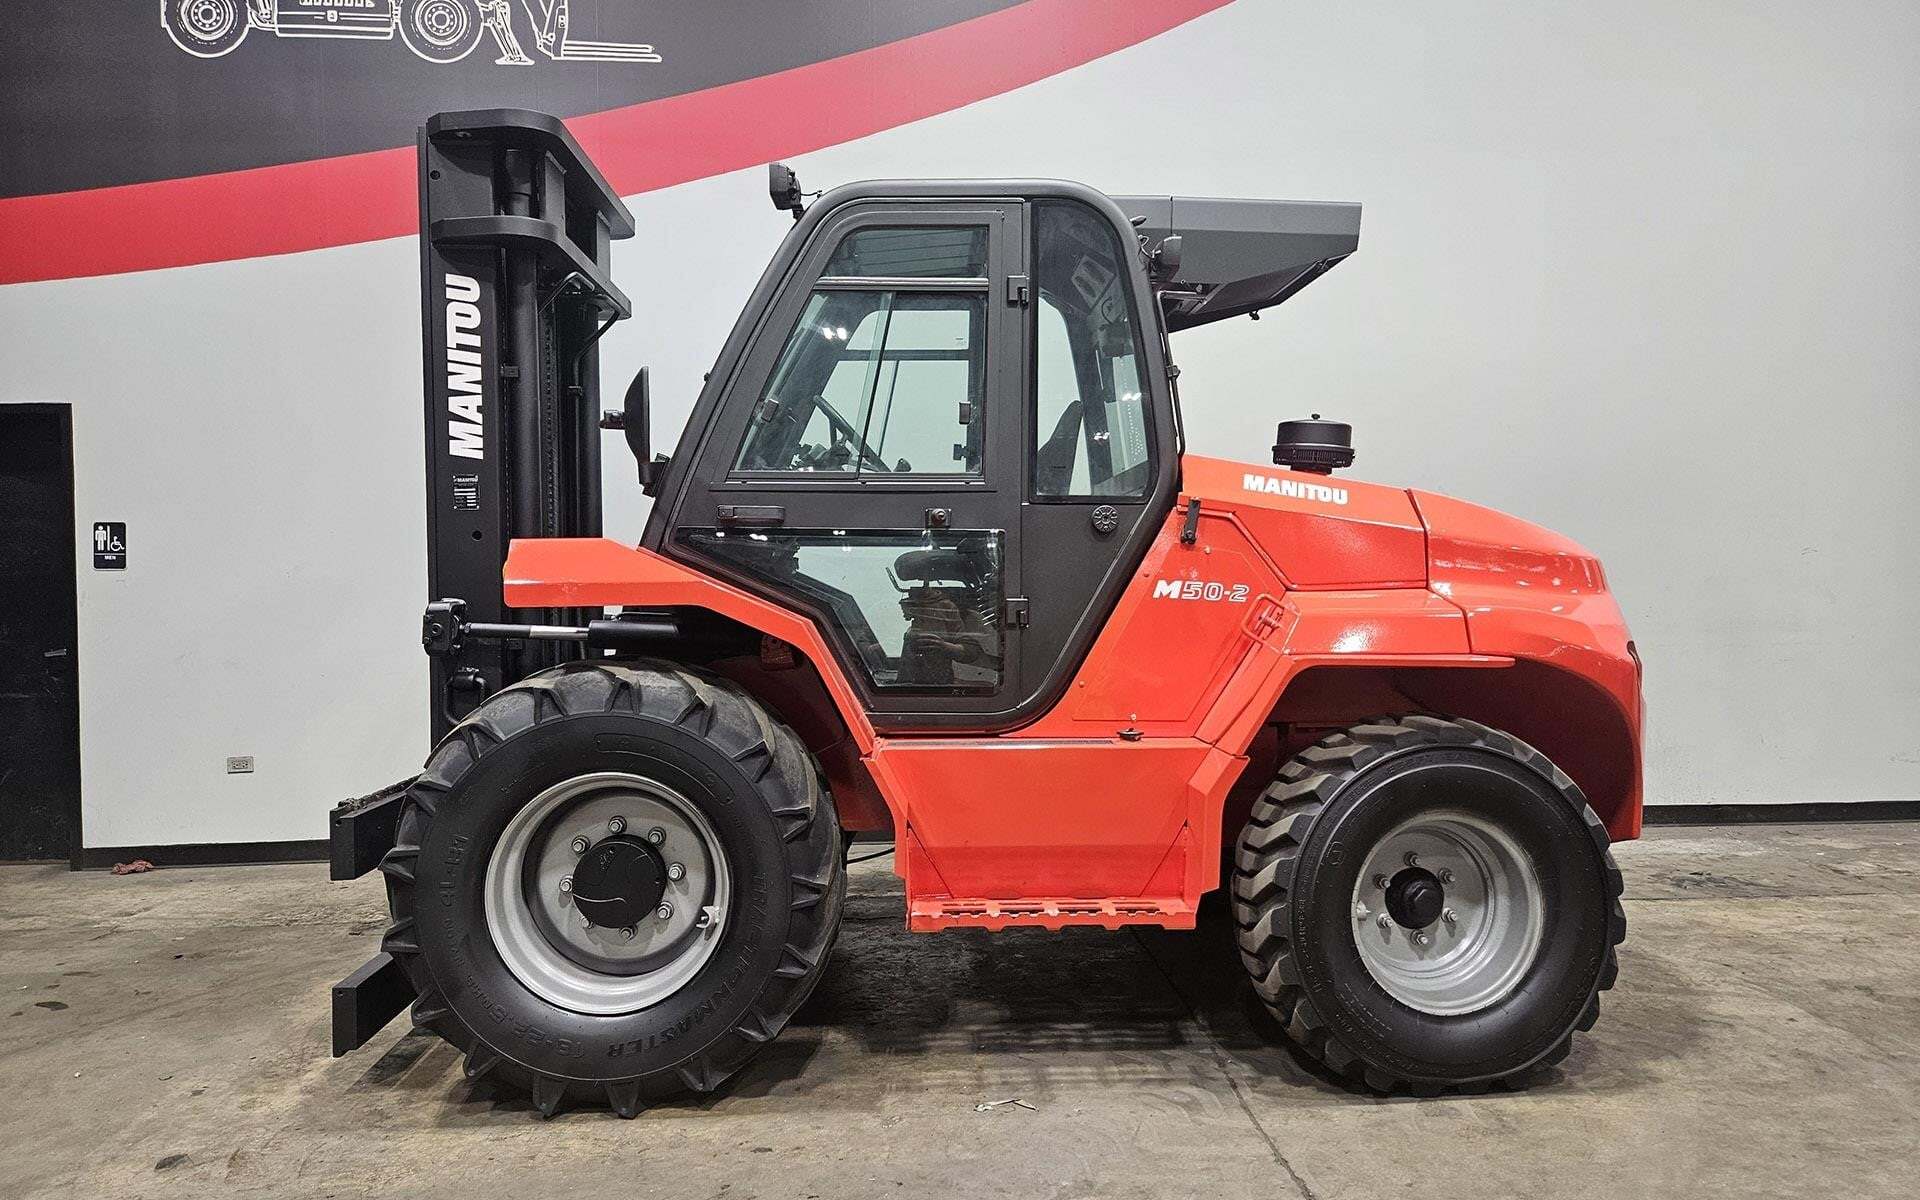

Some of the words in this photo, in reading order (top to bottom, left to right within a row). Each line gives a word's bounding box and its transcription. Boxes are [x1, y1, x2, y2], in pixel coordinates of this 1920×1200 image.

[445, 274, 484, 460] MANITOU
[1243, 473, 1349, 506] MANITOU
[1152, 579, 1250, 603] M50-2
